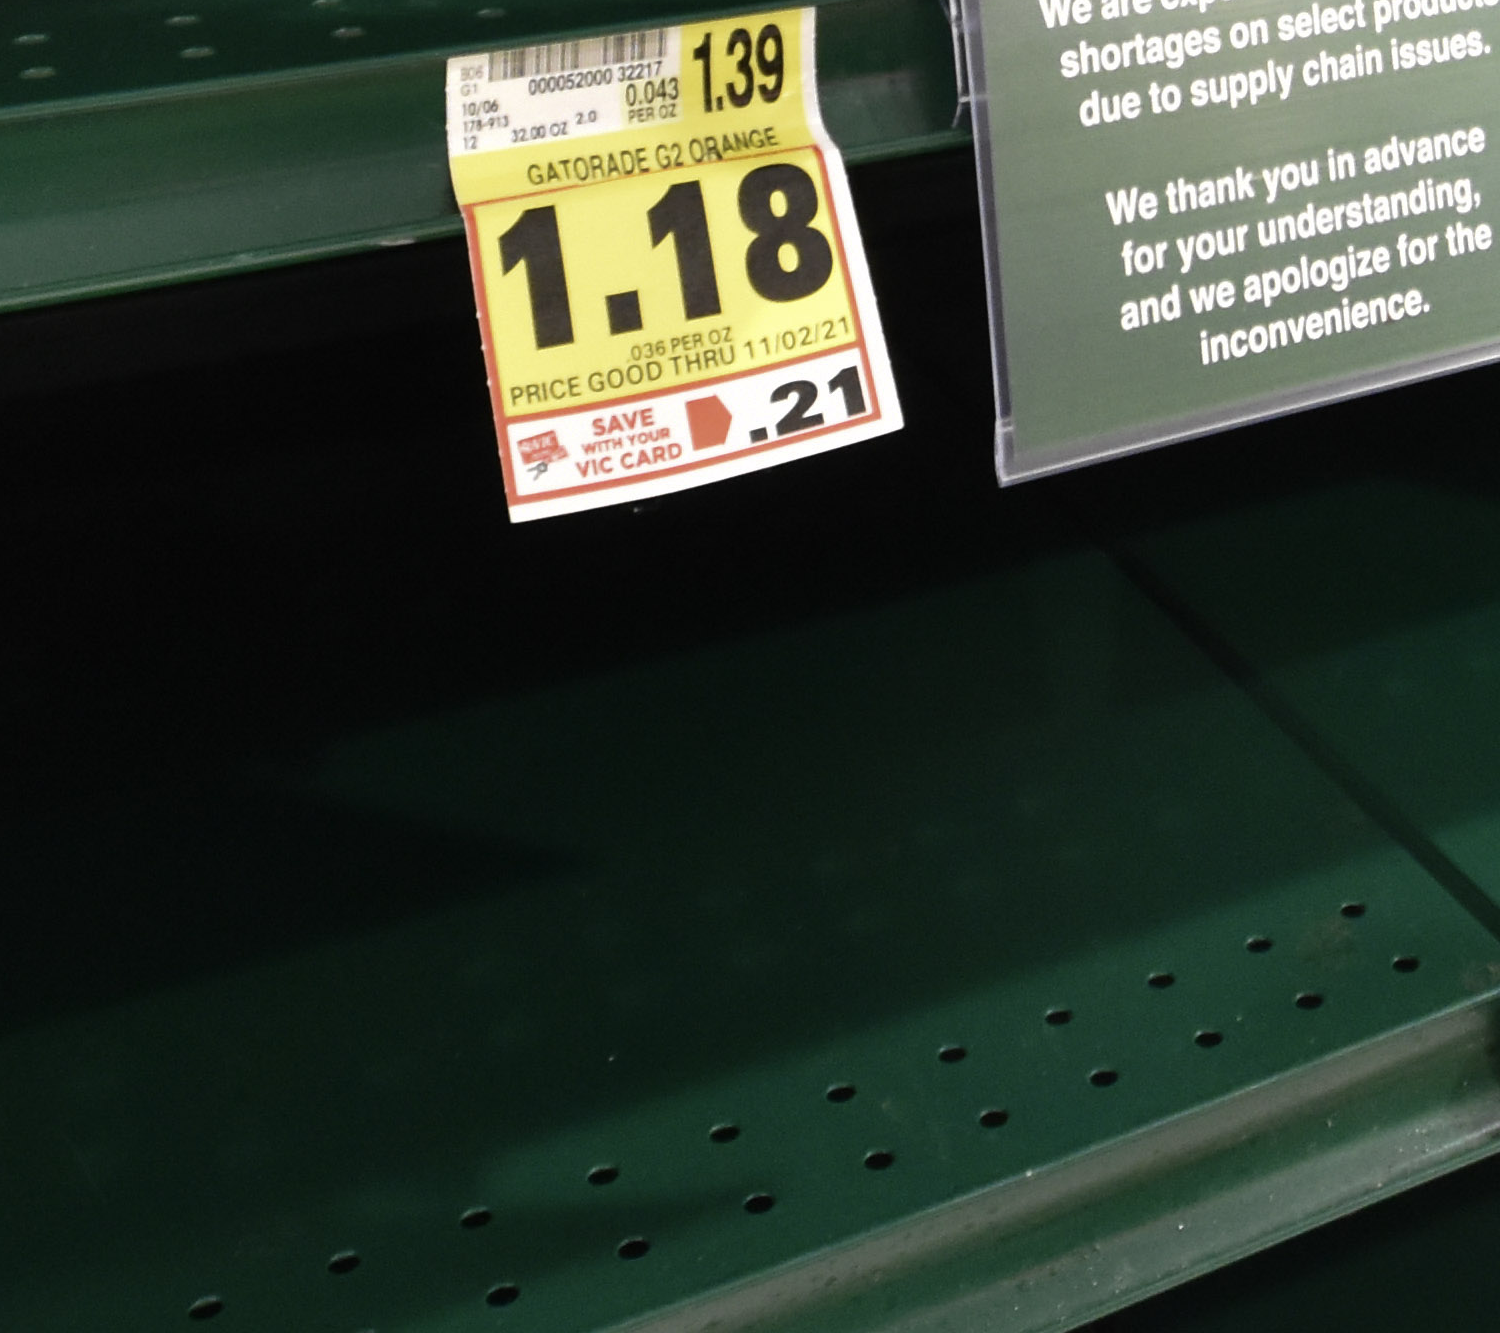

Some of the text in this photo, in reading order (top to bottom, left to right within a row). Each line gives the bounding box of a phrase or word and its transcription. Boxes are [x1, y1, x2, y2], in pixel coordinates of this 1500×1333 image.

[693, 24, 785, 114] 1.39
[1059, 19, 1221, 77] shortages
[1229, 17, 1269, 49] on
[462, 99, 499, 117] 10/06
[529, 61, 663, 96] 000052000 32217
[626, 77, 679, 107] 0.043
[1079, 30, 1492, 127] due to supply chain issues.
[550, 122, 568, 137] OZ
[629, 103, 677, 123] PER OZ
[464, 136, 477, 150] 12
[527, 127, 779, 186] GATORADE G2 ORANGE
[1106, 125, 1486, 225] We thank you in advance
[1121, 175, 1481, 276] for your understanding,
[498, 163, 834, 350] 1.18
[1120, 221, 1492, 330] and we apologize for the
[627, 326, 733, 362] .036 PER OZ
[1199, 289, 1431, 365] inconvenience.
[510, 316, 850, 407] PRICE GOOD THRU 11/02/21
[592, 408, 655, 436] SAVE
[749, 365, 867, 444] .21
[575, 443, 683, 478] VIC CARD
[582, 437, 623, 455] WITH
[628, 427, 670, 446] YOUR
